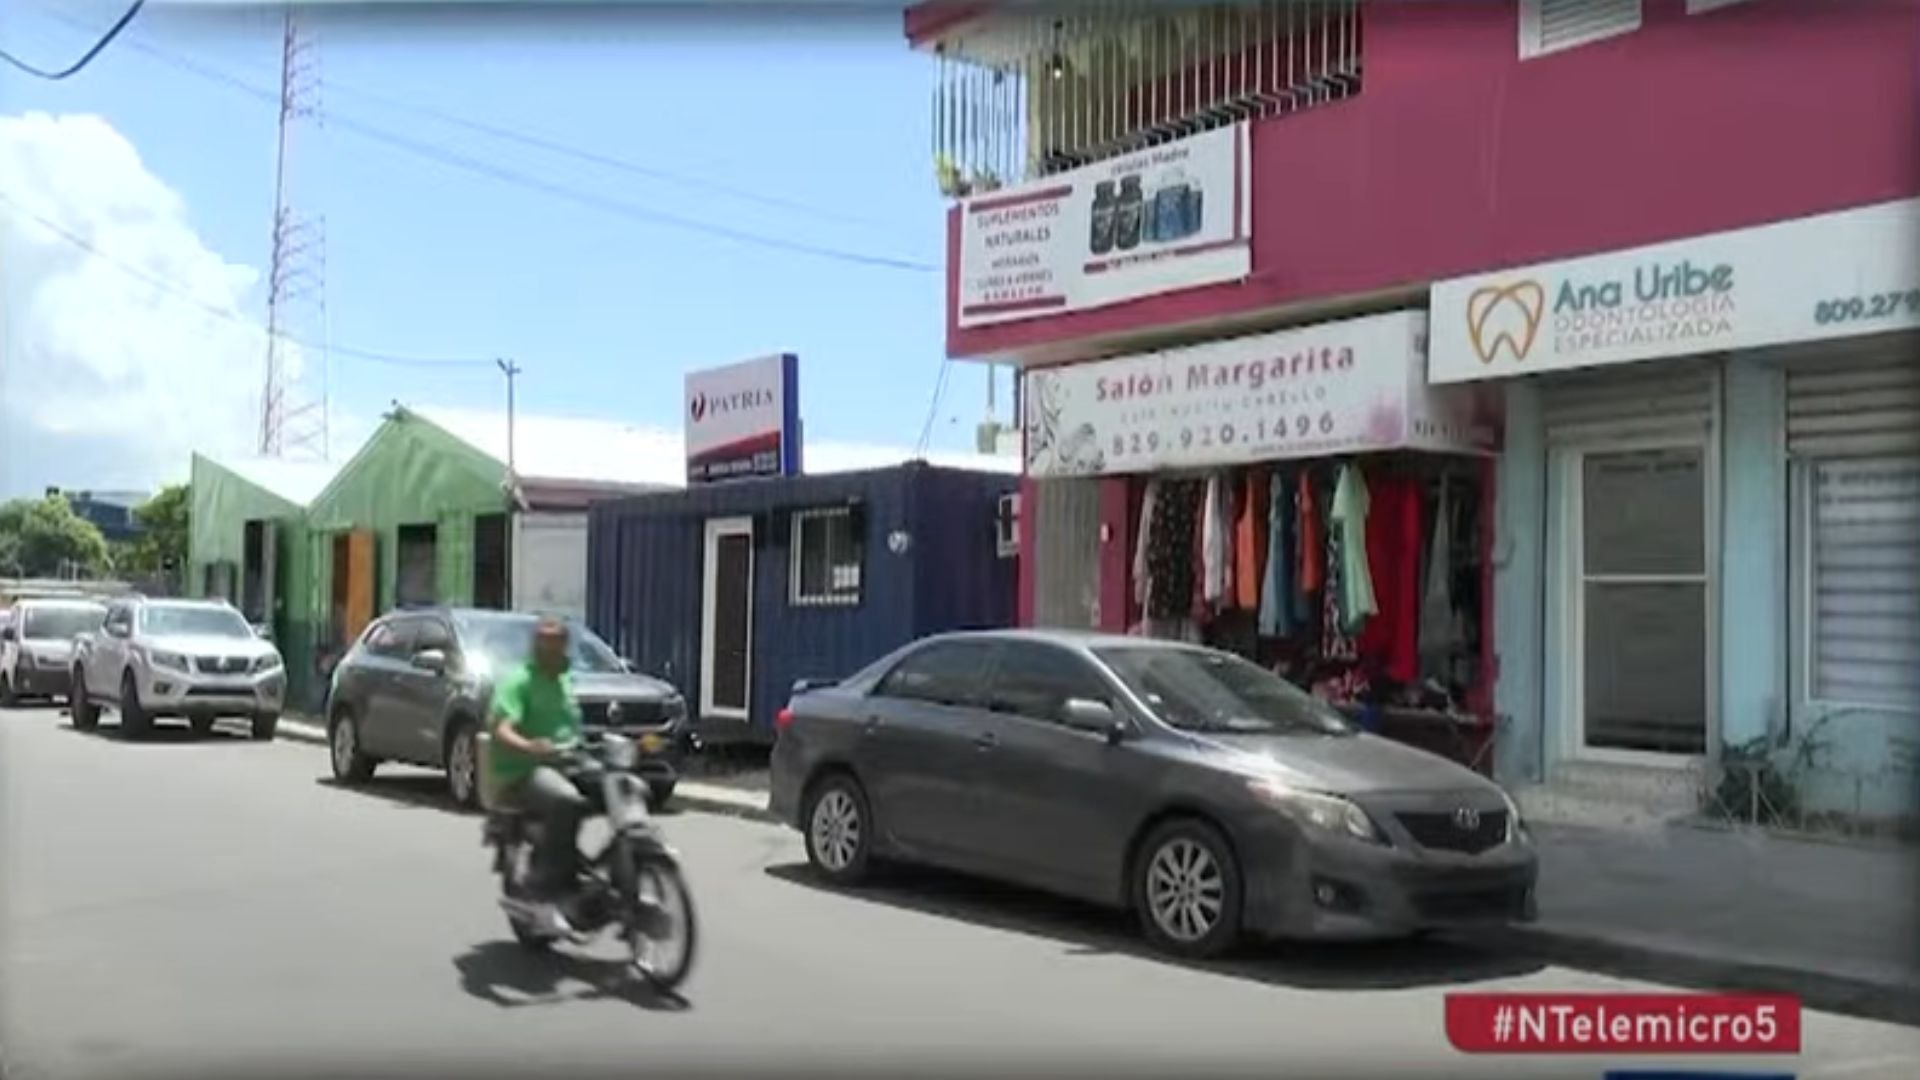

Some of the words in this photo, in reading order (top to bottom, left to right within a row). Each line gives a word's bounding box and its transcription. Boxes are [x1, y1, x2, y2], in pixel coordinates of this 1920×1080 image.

[977, 202, 1059, 229] SUPLEMENTOS
[985, 226, 1051, 248] NATURALES
[1554, 280, 1621, 314] Ana
[1634, 261, 1734, 301] Uribe
[1553, 318, 1734, 354] ESPECIALIZADA
[1187, 347, 1355, 391] Margarita
[709, 388, 774, 417] PATRIA
[1112, 411, 1334, 456] 829.920.1496
